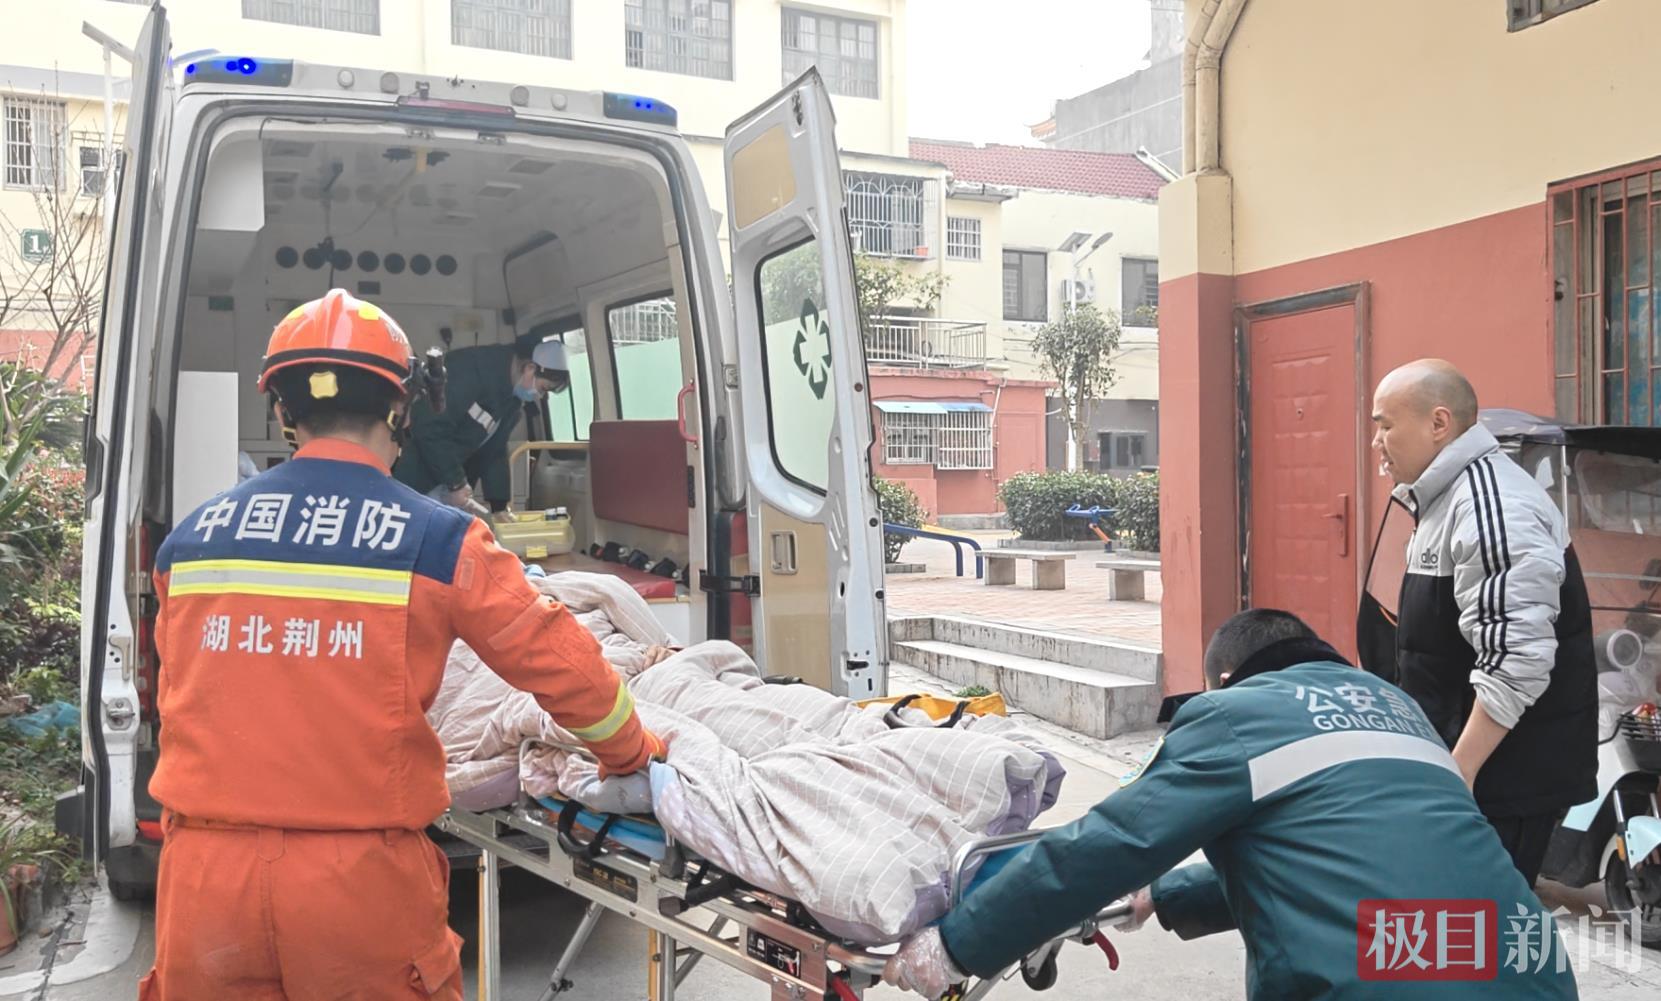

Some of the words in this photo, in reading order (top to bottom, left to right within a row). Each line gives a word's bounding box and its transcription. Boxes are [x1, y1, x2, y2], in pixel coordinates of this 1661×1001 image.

[194, 492, 411, 551] 中国消防
[202, 615, 363, 659] 湖北荆州
[1313, 714, 1416, 734] GONGAN
